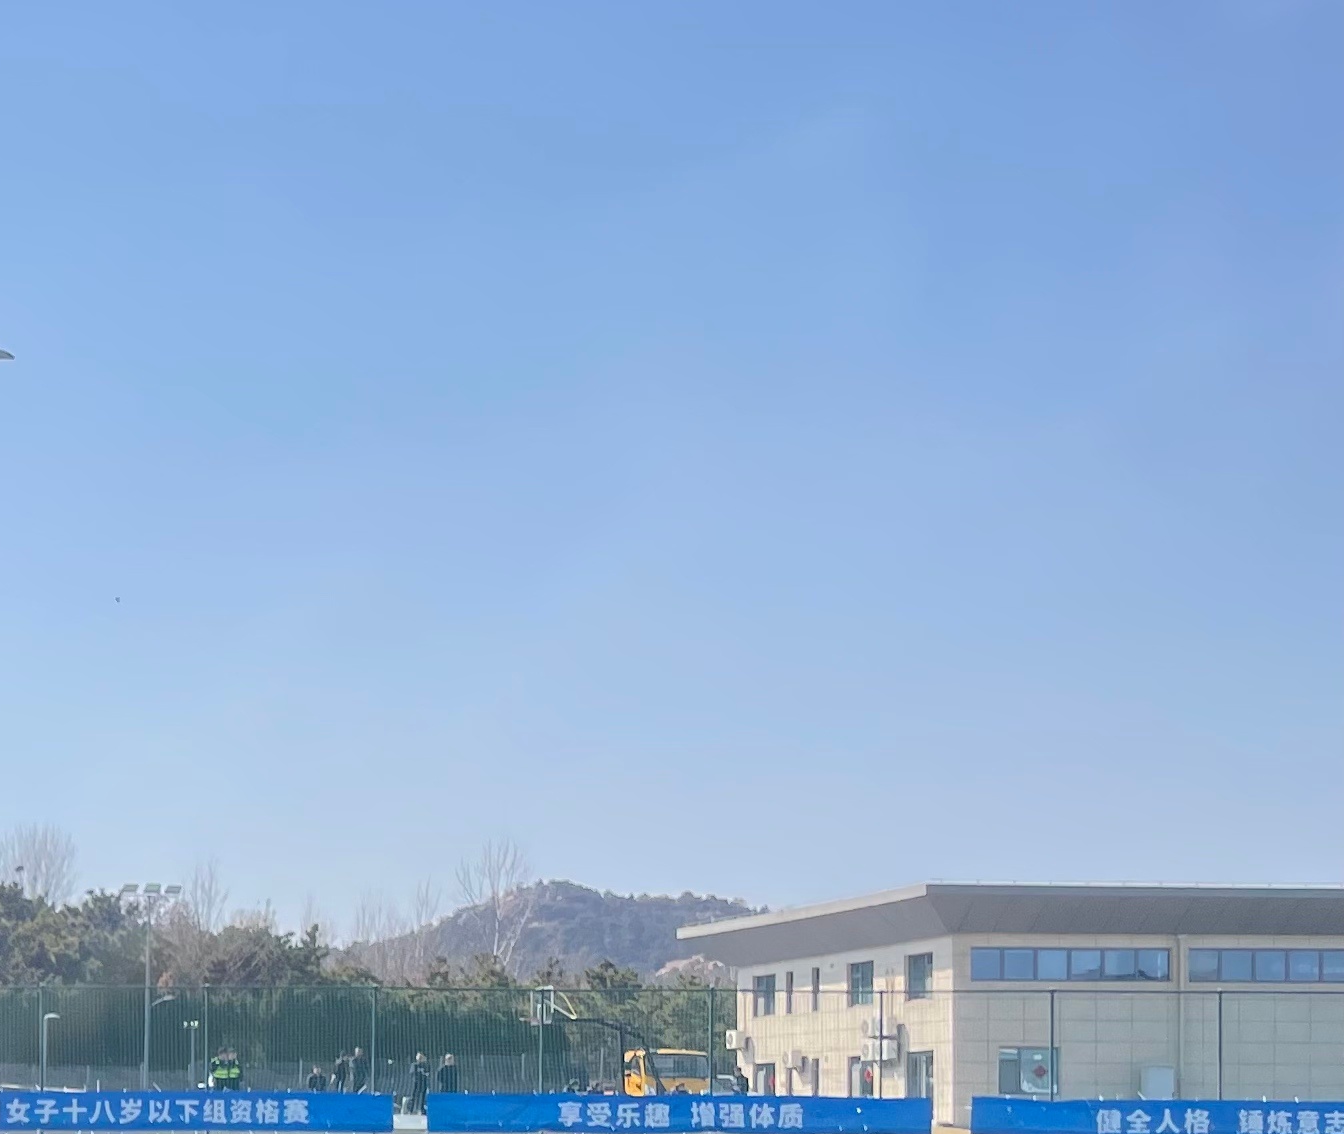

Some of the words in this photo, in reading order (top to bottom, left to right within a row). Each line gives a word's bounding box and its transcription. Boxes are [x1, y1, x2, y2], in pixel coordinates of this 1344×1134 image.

[558, 1101, 670, 1130] 享受乐趣
[691, 1103, 803, 1129] 增强体质
[1096, 1108, 1211, 1134] 健全人格
